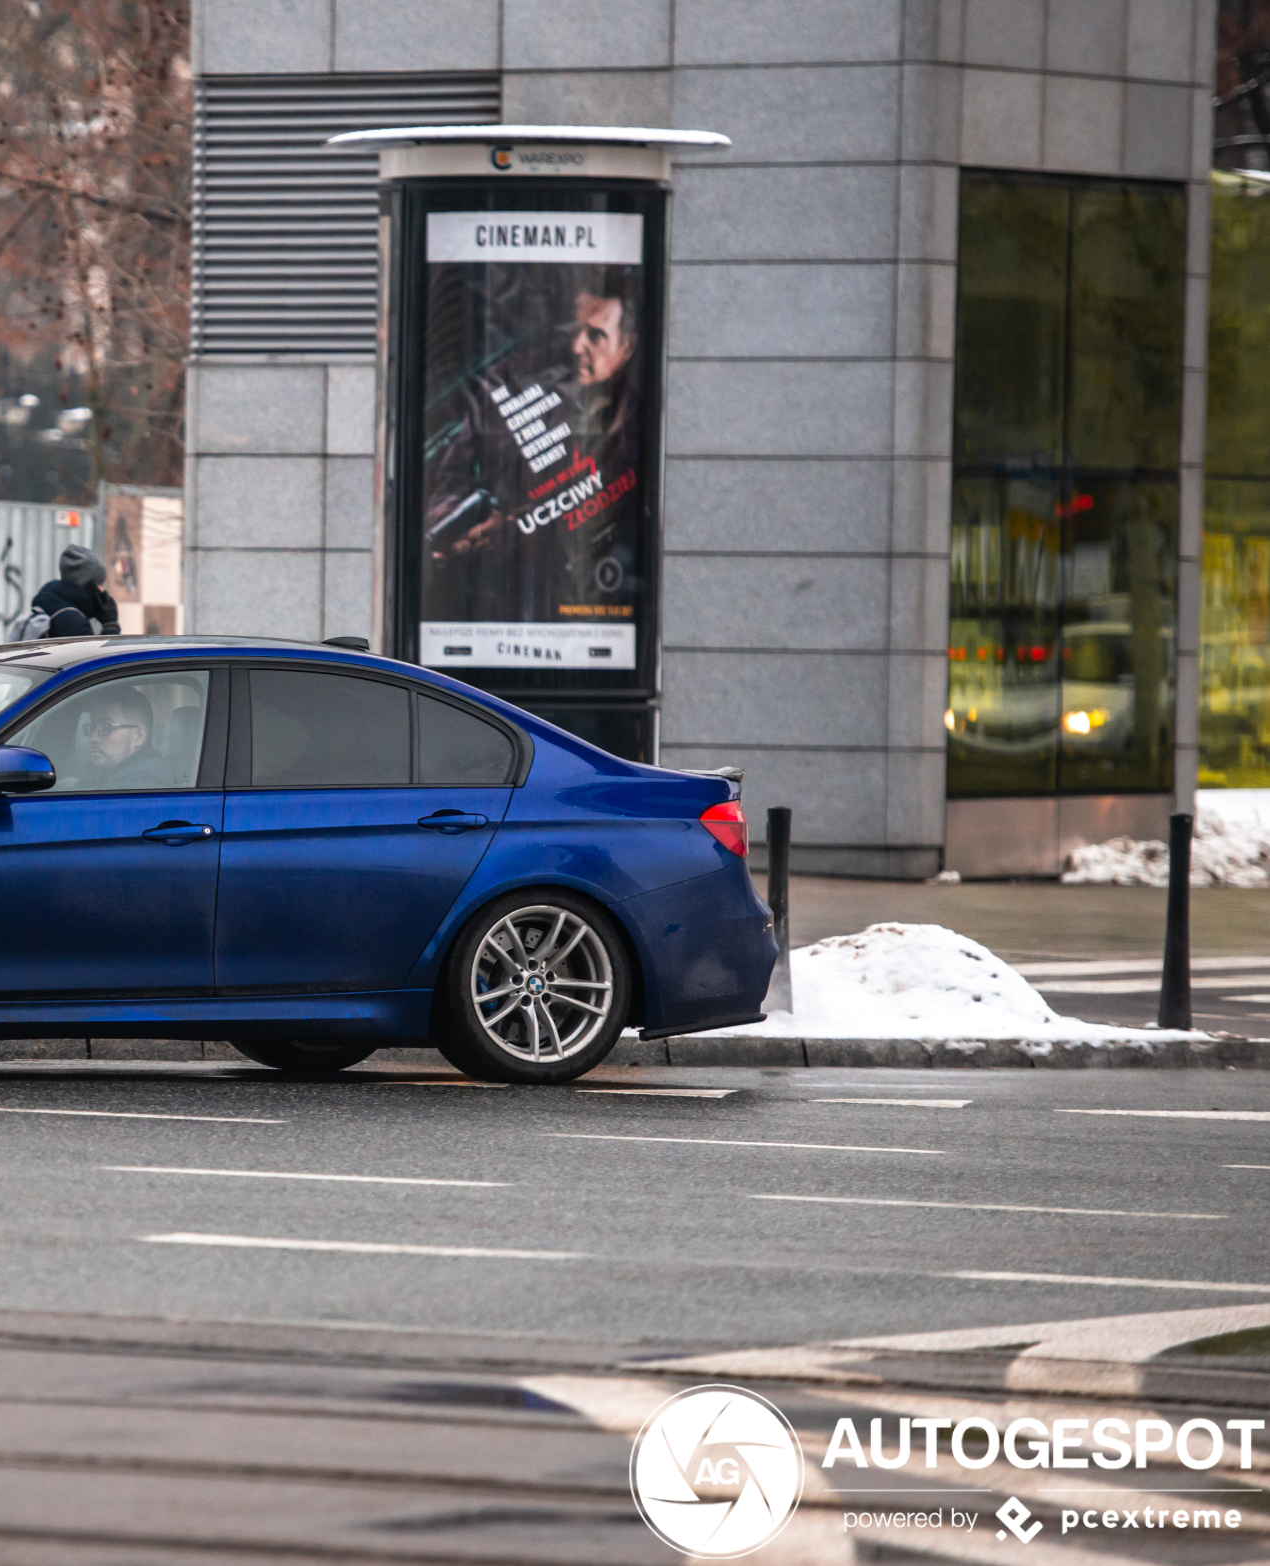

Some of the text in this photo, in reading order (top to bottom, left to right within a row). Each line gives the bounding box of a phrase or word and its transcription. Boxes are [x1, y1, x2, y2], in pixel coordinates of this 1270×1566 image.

[475, 224, 596, 248] CINEMAN.PL
[516, 470, 604, 535] UCZCIWY
[562, 468, 637, 531] ZŁODZIEJ
[497, 641, 562, 661] CINEMAN
